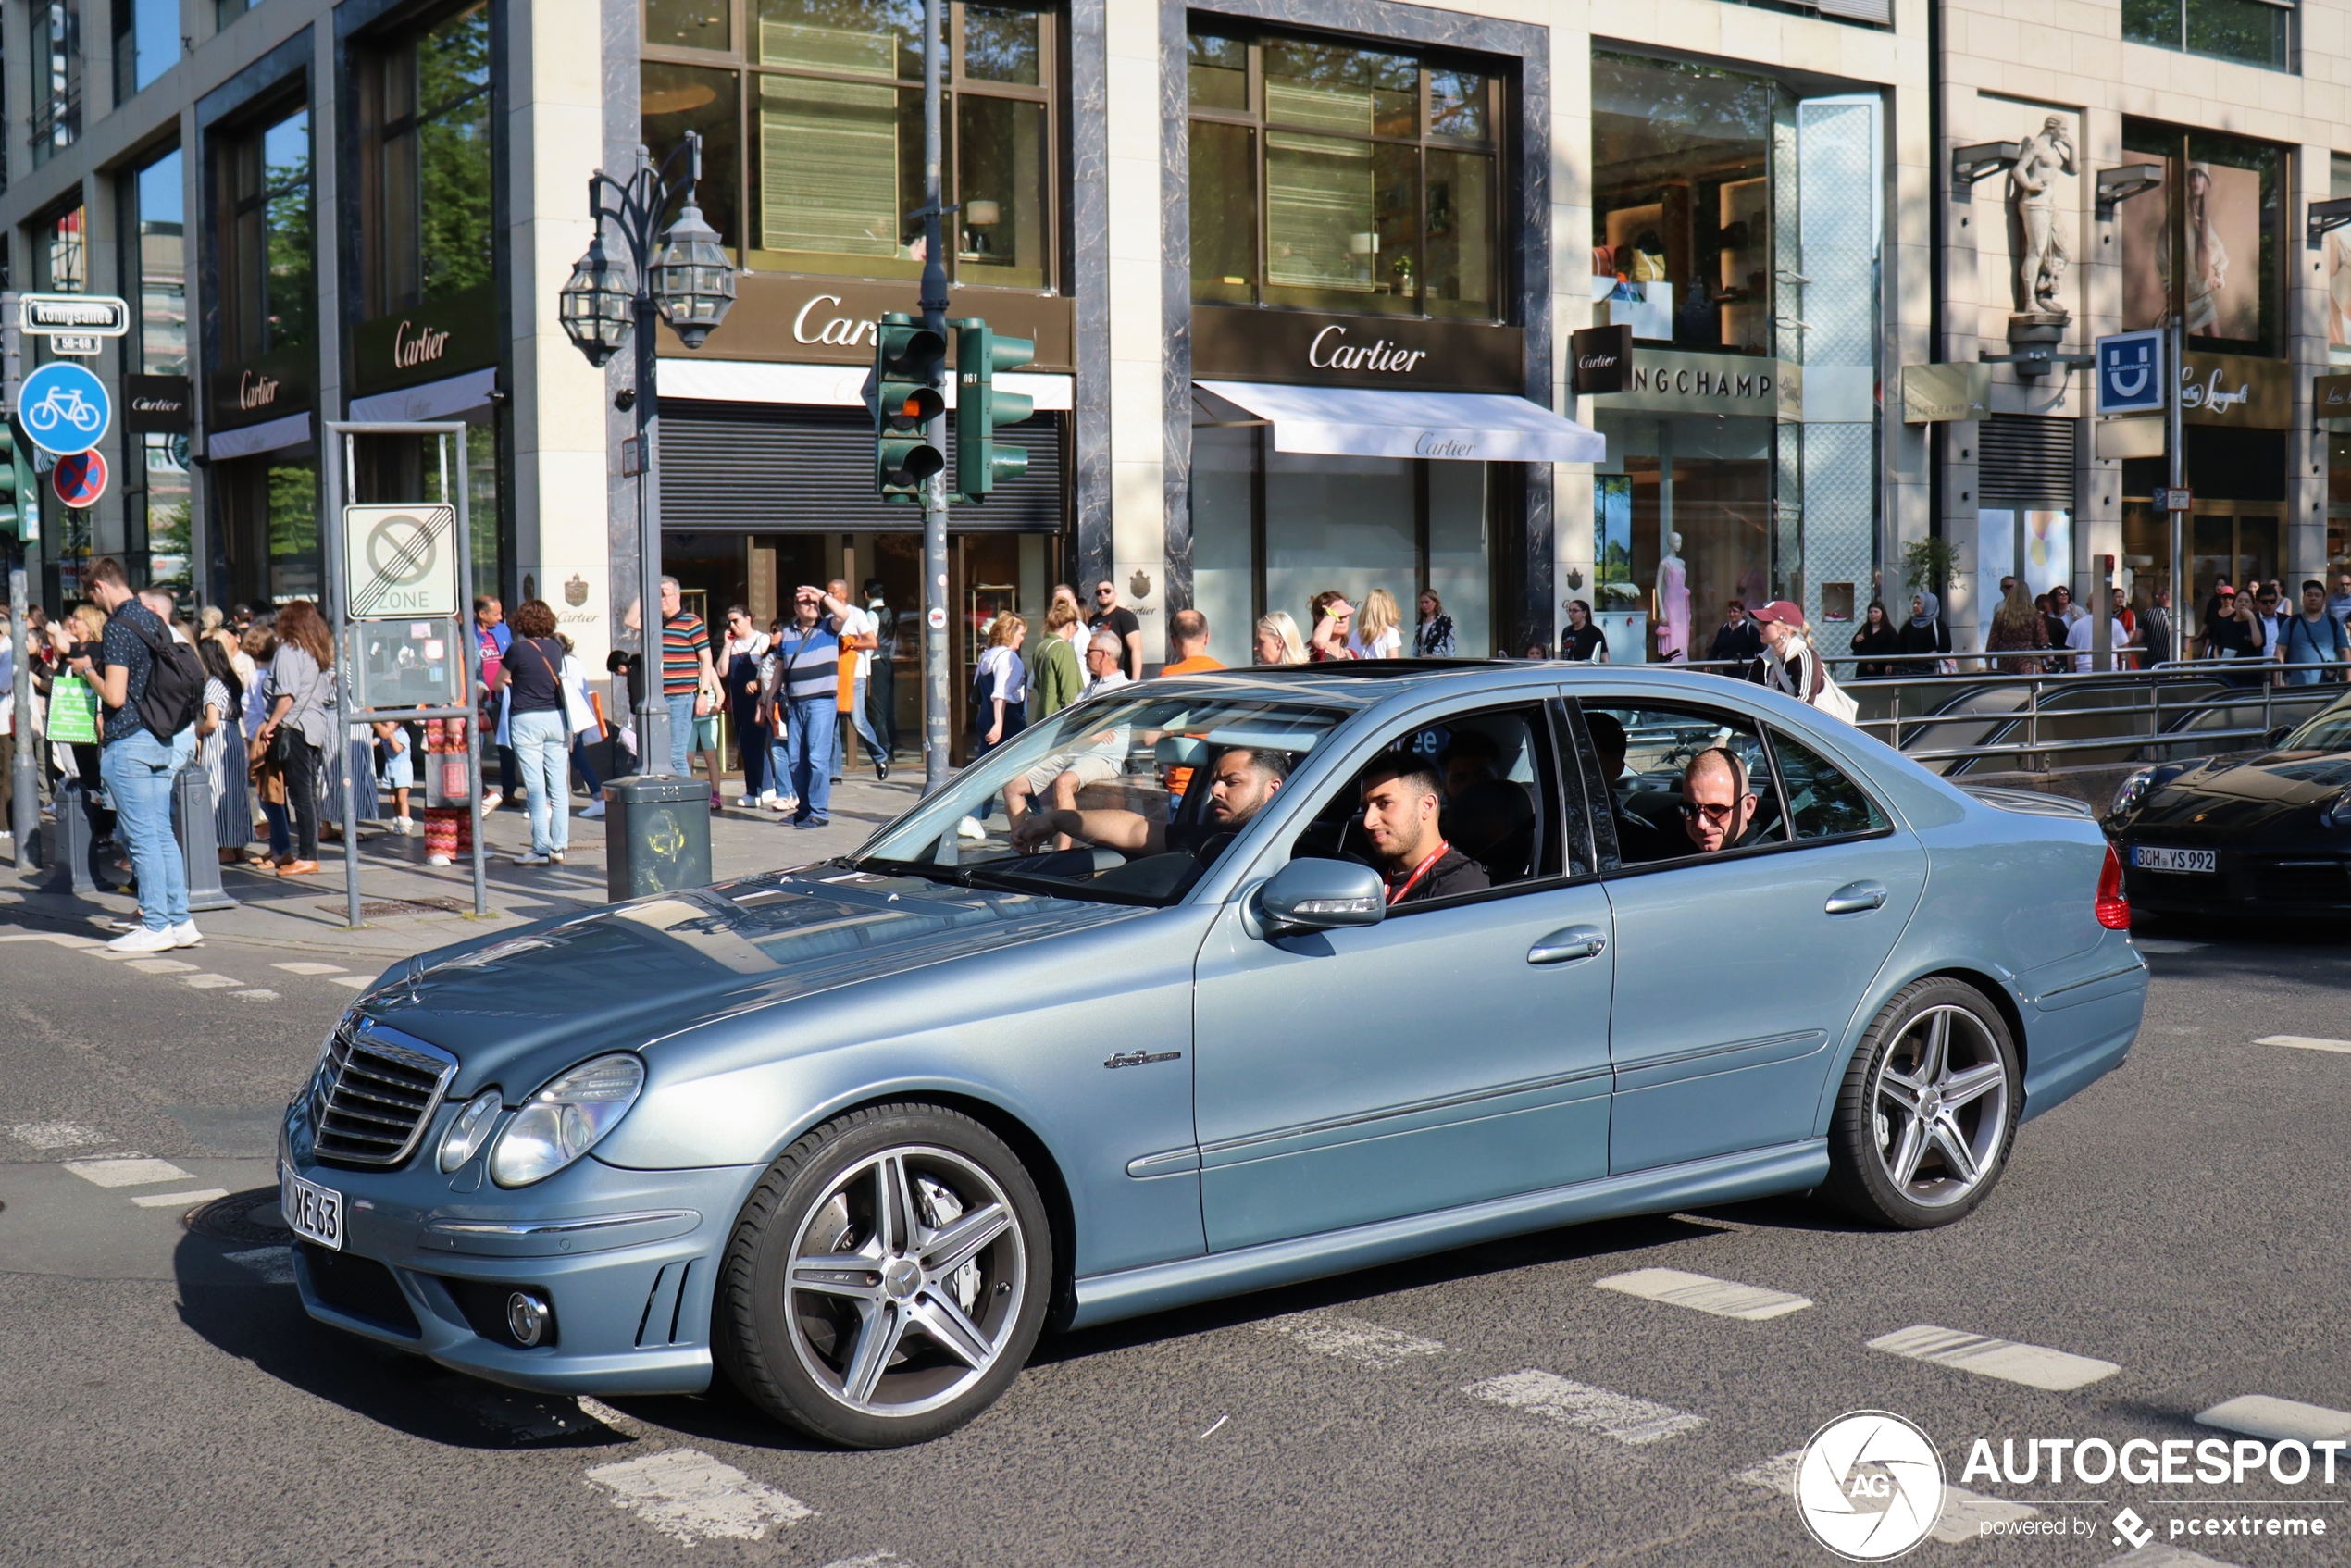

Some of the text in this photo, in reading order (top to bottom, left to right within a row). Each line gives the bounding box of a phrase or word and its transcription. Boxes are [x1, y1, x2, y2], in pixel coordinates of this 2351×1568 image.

[61, 337, 92, 349] 56-68
[394, 320, 450, 368] Cartier
[1309, 325, 1426, 372] Cartier
[1579, 355, 1617, 369] Cartier
[2108, 362, 2151, 372] stadtbahn
[240, 370, 280, 411] Cartier
[132, 396, 182, 412] Cartier
[1415, 431, 1476, 456] Cartier
[378, 591, 429, 609] ZONE
[556, 611, 600, 623] Cartier
[2138, 849, 2213, 870] BOH YS 992
[295, 1184, 316, 1233] XE
[317, 1194, 339, 1240] 63
